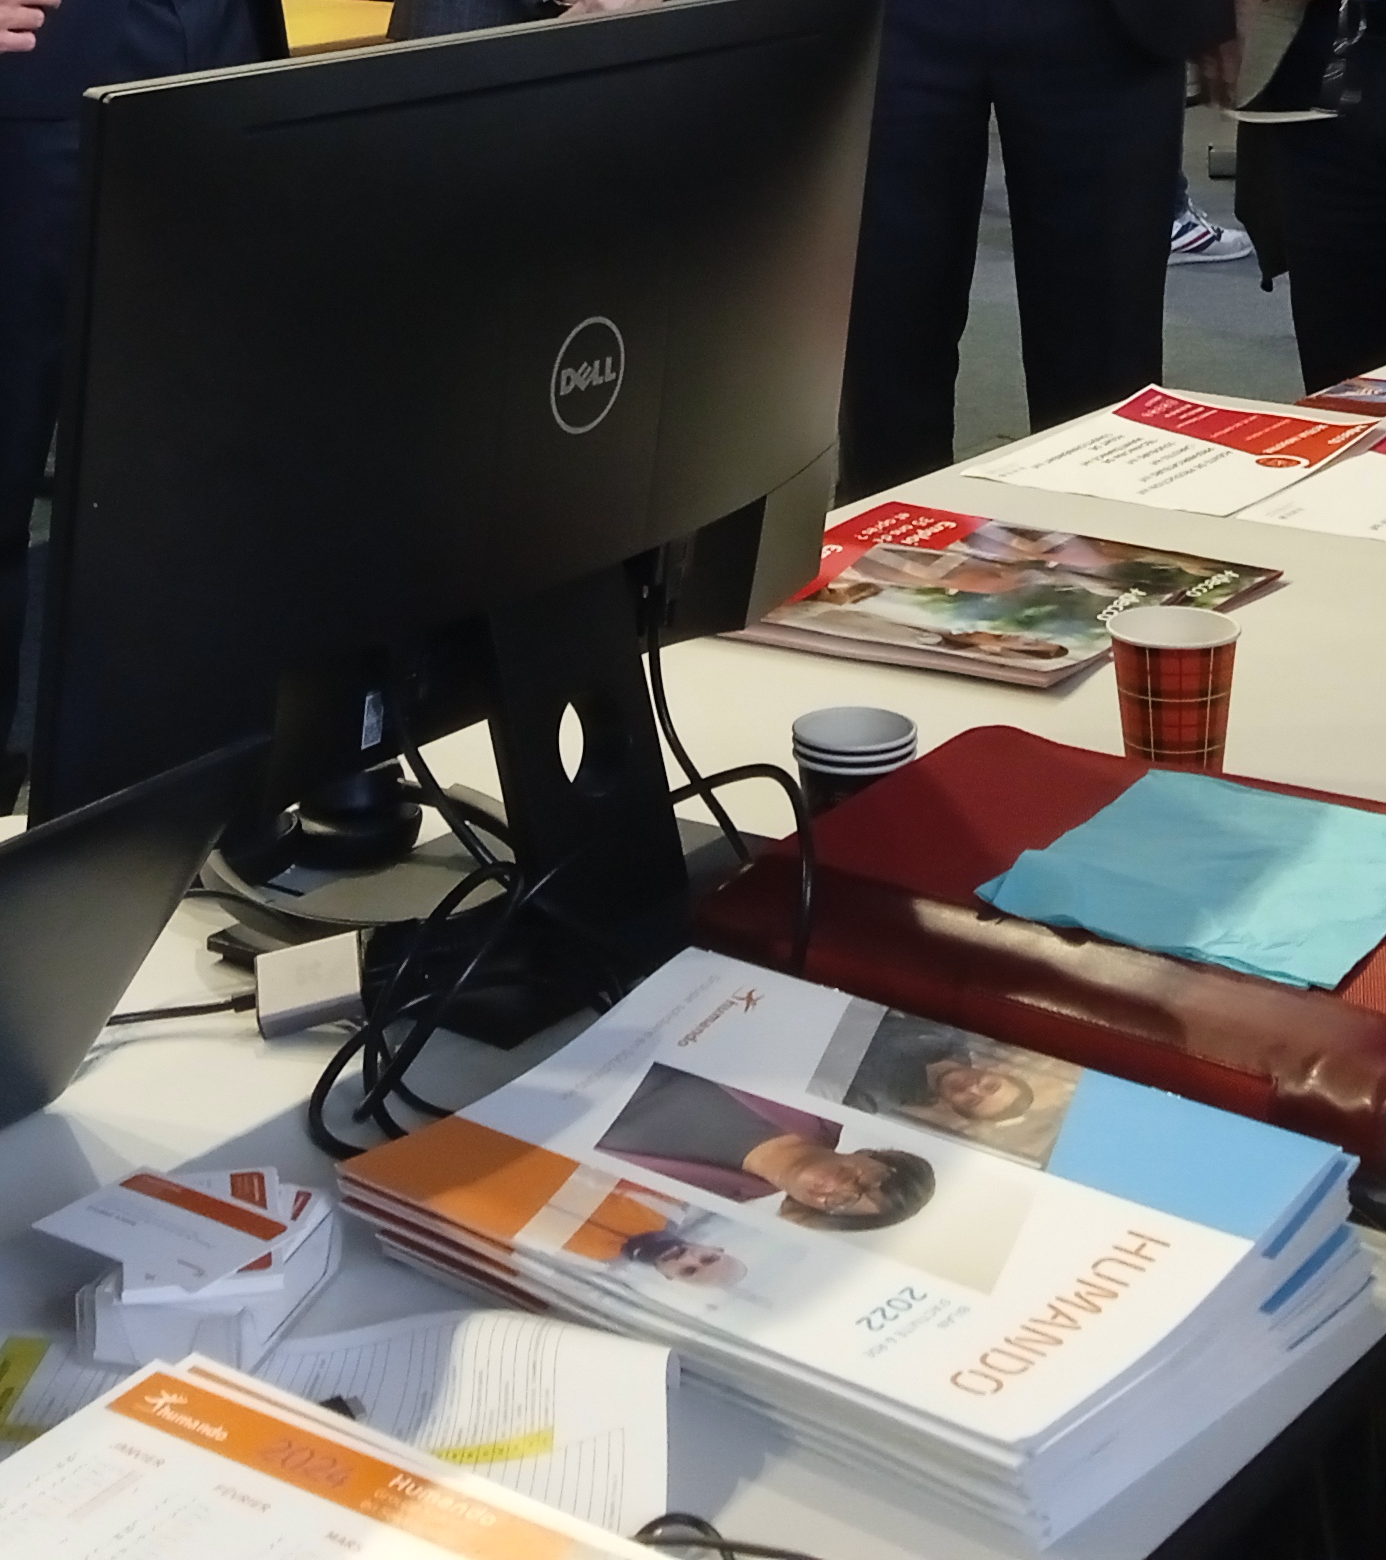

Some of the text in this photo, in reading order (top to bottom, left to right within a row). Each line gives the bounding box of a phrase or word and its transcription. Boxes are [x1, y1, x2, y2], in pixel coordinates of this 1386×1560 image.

[559, 354, 617, 397] DELL
[854, 1285, 928, 1333] 2022
[949, 1229, 1172, 1396] HUMANDO
[108, 1441, 166, 1469] JANVIER
[157, 1403, 358, 1490] humando 2024
[388, 1472, 498, 1528] Humando
